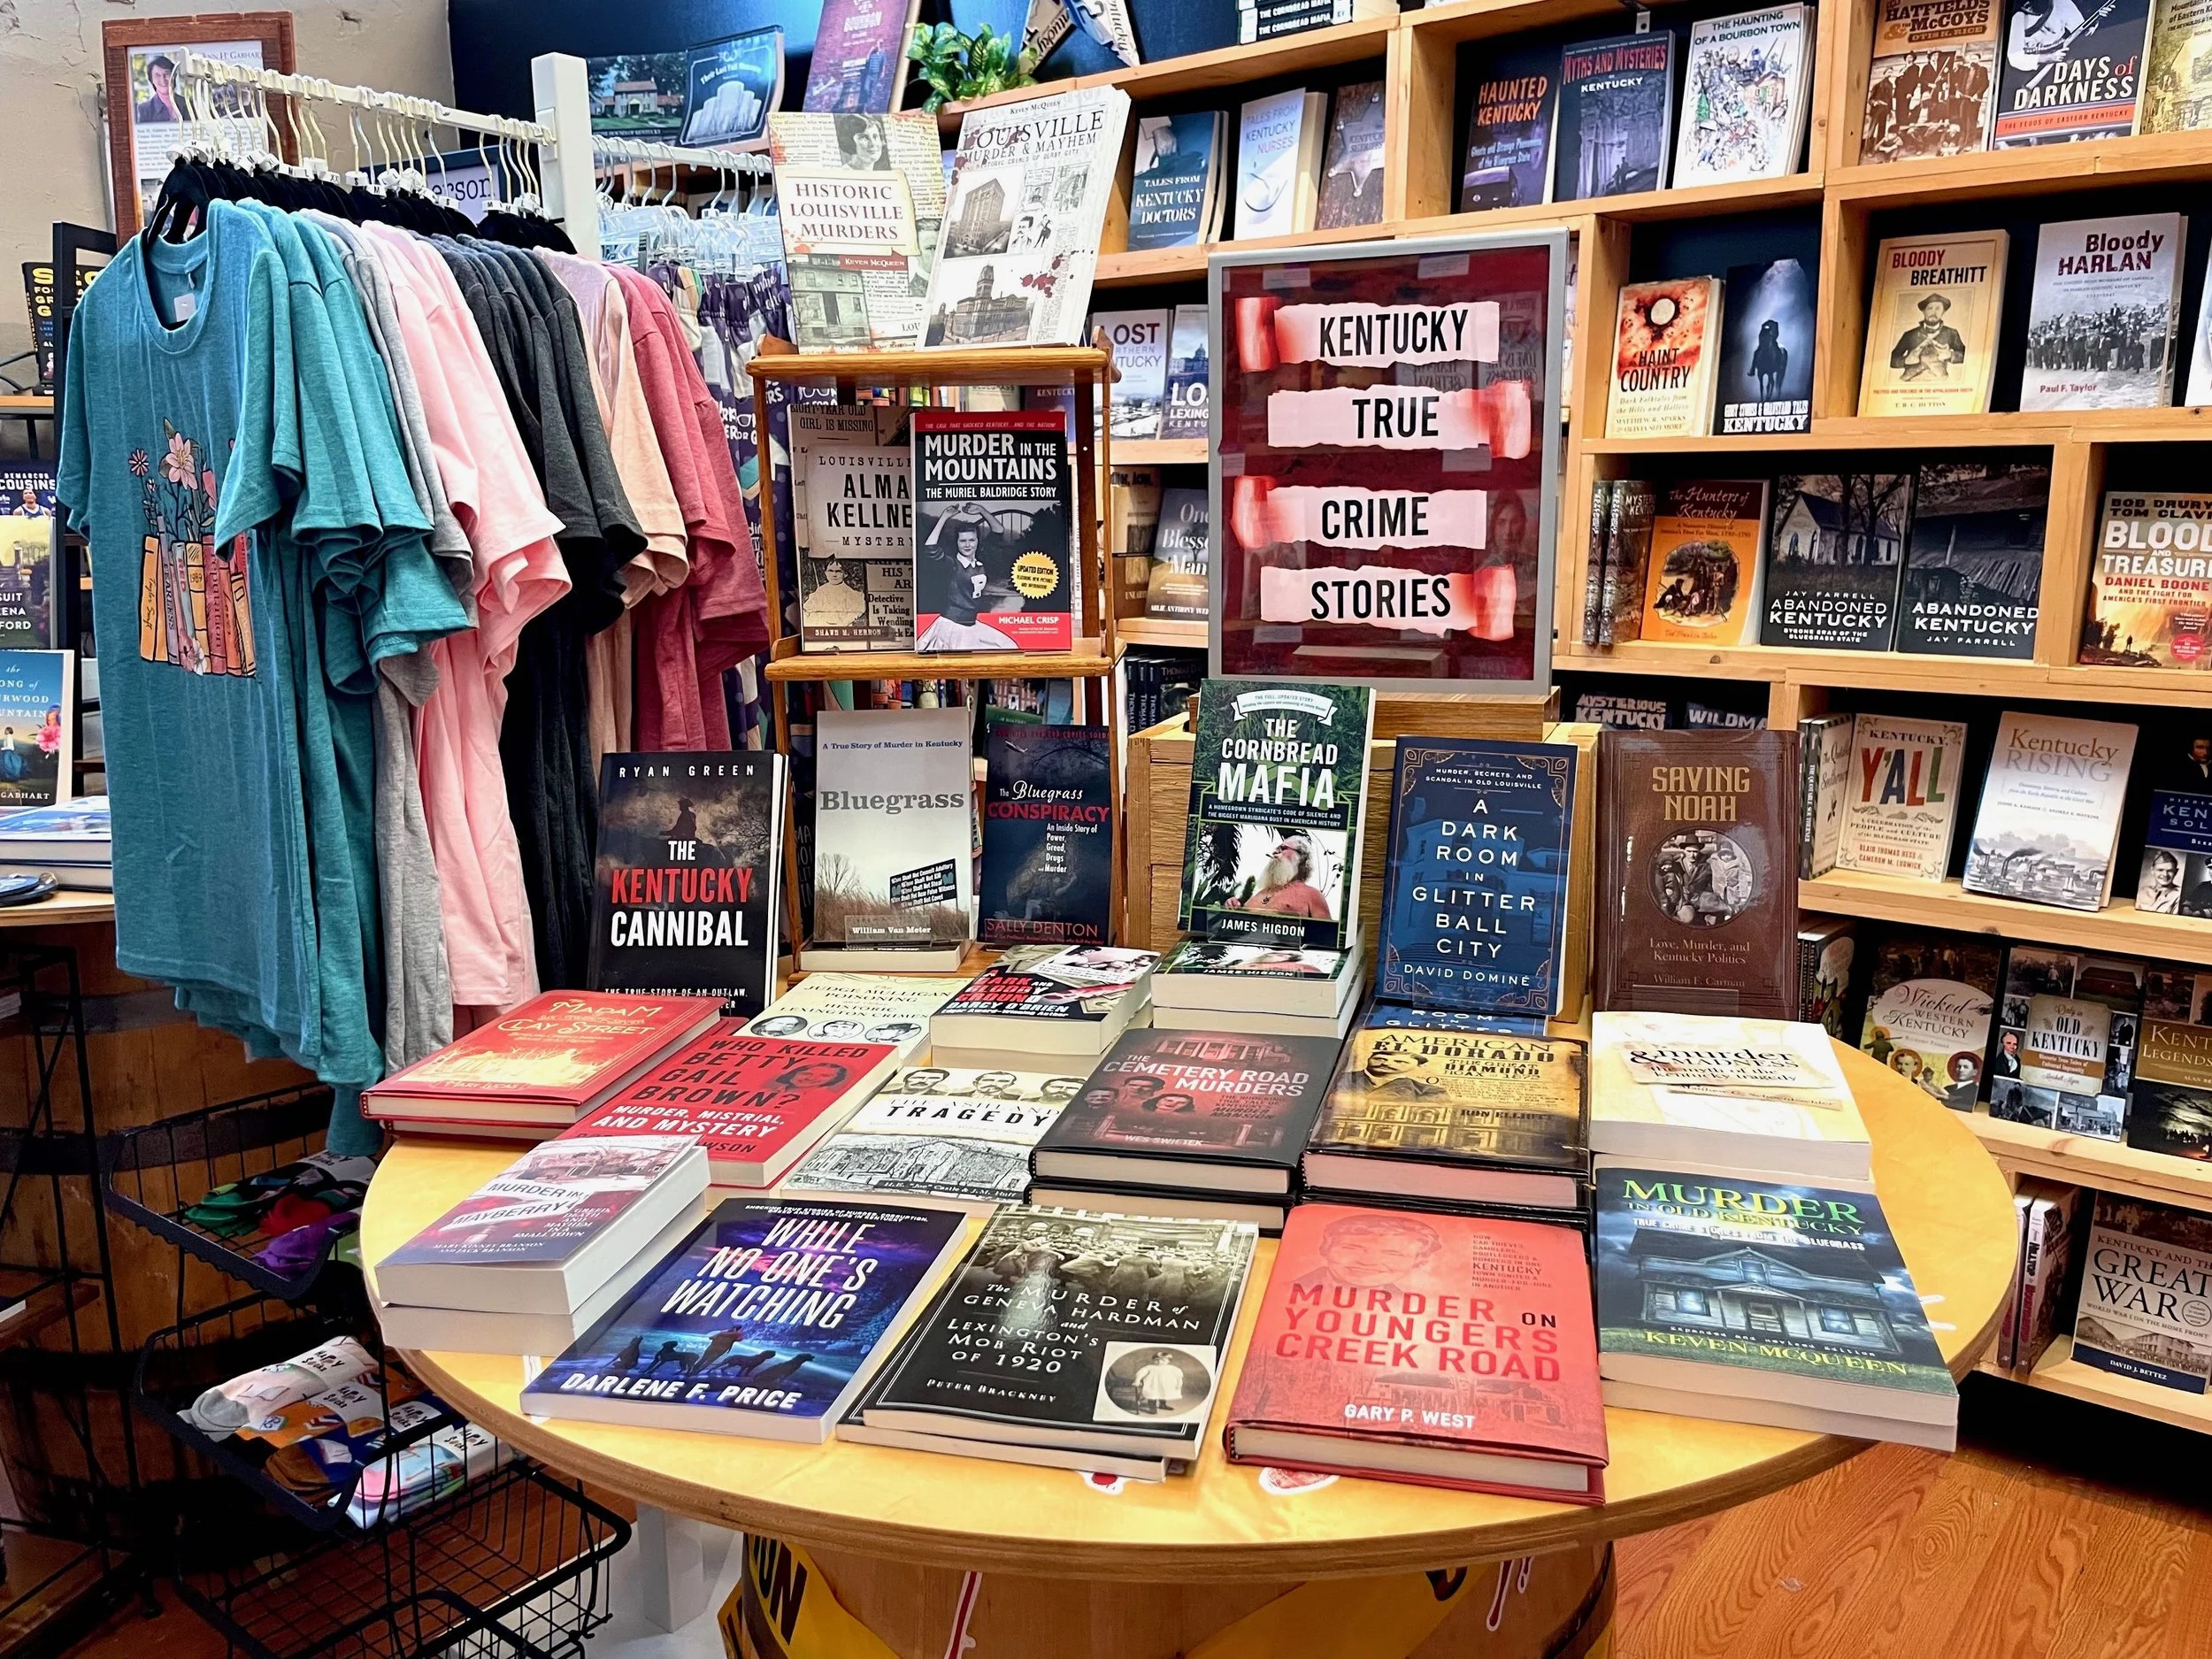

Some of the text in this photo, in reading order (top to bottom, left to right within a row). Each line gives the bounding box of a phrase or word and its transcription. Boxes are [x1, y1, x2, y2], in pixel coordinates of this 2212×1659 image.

[1694, 20, 1801, 46] OF A BOURBON TOWN
[1712, 11, 1784, 32] THE HAUNTING
[1563, 44, 1665, 84] MYTHS AND MYSTERIES
[2054, 56, 2137, 83] DAYS of
[1478, 75, 1548, 102] HAUNTED
[1581, 76, 1643, 93] KENTUCKY
[2014, 76, 2133, 111] DARKNESS
[1477, 102, 1542, 127] KENTUCKY
[960, 110, 1104, 151] LOUISVILLE
[964, 132, 1096, 162] MURDER & MAYHEM
[796, 183, 892, 200] HISTORIC
[1135, 188, 1204, 208] KENTUCKY
[791, 203, 903, 219] LOUISVILLE
[1141, 206, 1196, 223] DOCTORS
[801, 222, 898, 240] MURDERS
[2085, 230, 2163, 252] Bloody
[1893, 250, 1945, 268] BLOODY
[2058, 251, 2151, 275] HARLAN
[1910, 266, 1987, 286] BREATHITT
[1320, 309, 1468, 357] KENTUCKY
[1639, 349, 1680, 367] HAINT
[1620, 366, 1691, 392] COUNTRY
[1352, 396, 1440, 439] TRUE
[1724, 415, 1808, 433] KENTUCKY
[926, 434, 1056, 457] MURDER IN THE
[926, 458, 1056, 481] MOUNTAINS
[844, 474, 910, 499] ALMA
[926, 487, 1056, 498] THE MURIEL BALDRIDGE STORY
[1322, 496, 1429, 540] CRIME
[2105, 577, 2209, 591] DANIEL BOONE
[1311, 578, 1451, 619] STORIES
[1771, 599, 1886, 613] ABANDONED
[1770, 612, 1887, 628] KENTUCKY
[1912, 603, 2039, 619] ABANDONED
[1915, 618, 2034, 635] KENTUCKY
[1265, 718, 1298, 738] THE
[1870, 730, 1947, 746] KENTUCKY,
[851, 741, 872, 750] Story
[926, 740, 963, 749] Kentucky
[1222, 738, 1338, 765] CORNBREAD
[2008, 728, 2119, 765] Kentucky
[619, 765, 755, 778] RYAN GREEN
[1652, 766, 1749, 793] SAVING
[1861, 747, 1945, 806] Y'ALL
[1, 791, 50, 800] GABHART
[1012, 780, 1083, 803] Bluegrass
[1217, 762, 1334, 809] MAFIA
[820, 791, 964, 815] Bluegrass
[988, 802, 1110, 822] CONSPIRACY
[1664, 795, 1737, 821] NOAH
[1441, 822, 1517, 841] DARK
[669, 841, 696, 860] THE
[1437, 846, 1517, 866] ROOM
[612, 868, 752, 903] KENTUCKY
[1413, 887, 1535, 911] GLITTER
[611, 911, 749, 947] CANNIBAL
[986, 919, 1098, 936] SALLY DENTON
[1221, 918, 1305, 937] JAMES HIGDON
[1435, 914, 1506, 934] BALL
[1437, 939, 1502, 957] CITY
[1404, 964, 1530, 987] DAVID DOMINÉ
[1894, 985, 1971, 1014] Wicked
[498, 1019, 559, 1031] CLAY
[557, 1022, 656, 1034] STREET
[1883, 1010, 1970, 1039] KENTUCKY
[1914, 1009, 1974, 1028] WESTERN
[2056, 1017, 2080, 1034] OLD
[709, 1041, 869, 1058] WHO KILLED
[1381, 1034, 1550, 1051] AMERICAN
[2032, 1032, 2101, 1057] KENTUCKY
[680, 1053, 807, 1070] BETTY
[1103, 1062, 1309, 1084] CEMETERY ROAD
[659, 1069, 742, 1085] GAIL
[1175, 1078, 1304, 1096] MURDERS
[631, 1087, 800, 1110] BROWN?
[887, 1106, 1048, 1126] TRAGEDY
[488, 1183, 565, 1198] MURDER
[1623, 1179, 1864, 1224] MURDER
[452, 1202, 567, 1225] MAYBERRY
[1628, 1202, 1864, 1235] IN OLD KENTUCKY
[761, 1217, 876, 1255] WHILE
[2097, 1235, 2162, 1256] KENTUCKY
[697, 1247, 878, 1291] NO ONE'S
[661, 1279, 856, 1328] WATCHING
[1020, 1286, 1161, 1312] MURDER
[1289, 1284, 1494, 1322] MURDER
[2092, 1274, 2180, 1322] WAR
[964, 1295, 1200, 1330] GENEVA HARDMAN
[1522, 1312, 1556, 1327] ON
[948, 1317, 1098, 1347] LEXINGTON'S
[1285, 1308, 1557, 1354] YOUNGERS
[949, 1333, 1082, 1359] MOB RIOT
[1276, 1333, 1559, 1382] CREEK ROAD
[1646, 1332, 1907, 1375] KEVEN MCQUEEN
[952, 1350, 1062, 1373] OF 1920
[2110, 1360, 2131, 1371] DAVID
[2139, 1368, 2167, 1379] BETTEZ
[561, 1373, 802, 1409] DARLENE F. PRICE
[1344, 1404, 1475, 1428] GARY P. WEST
